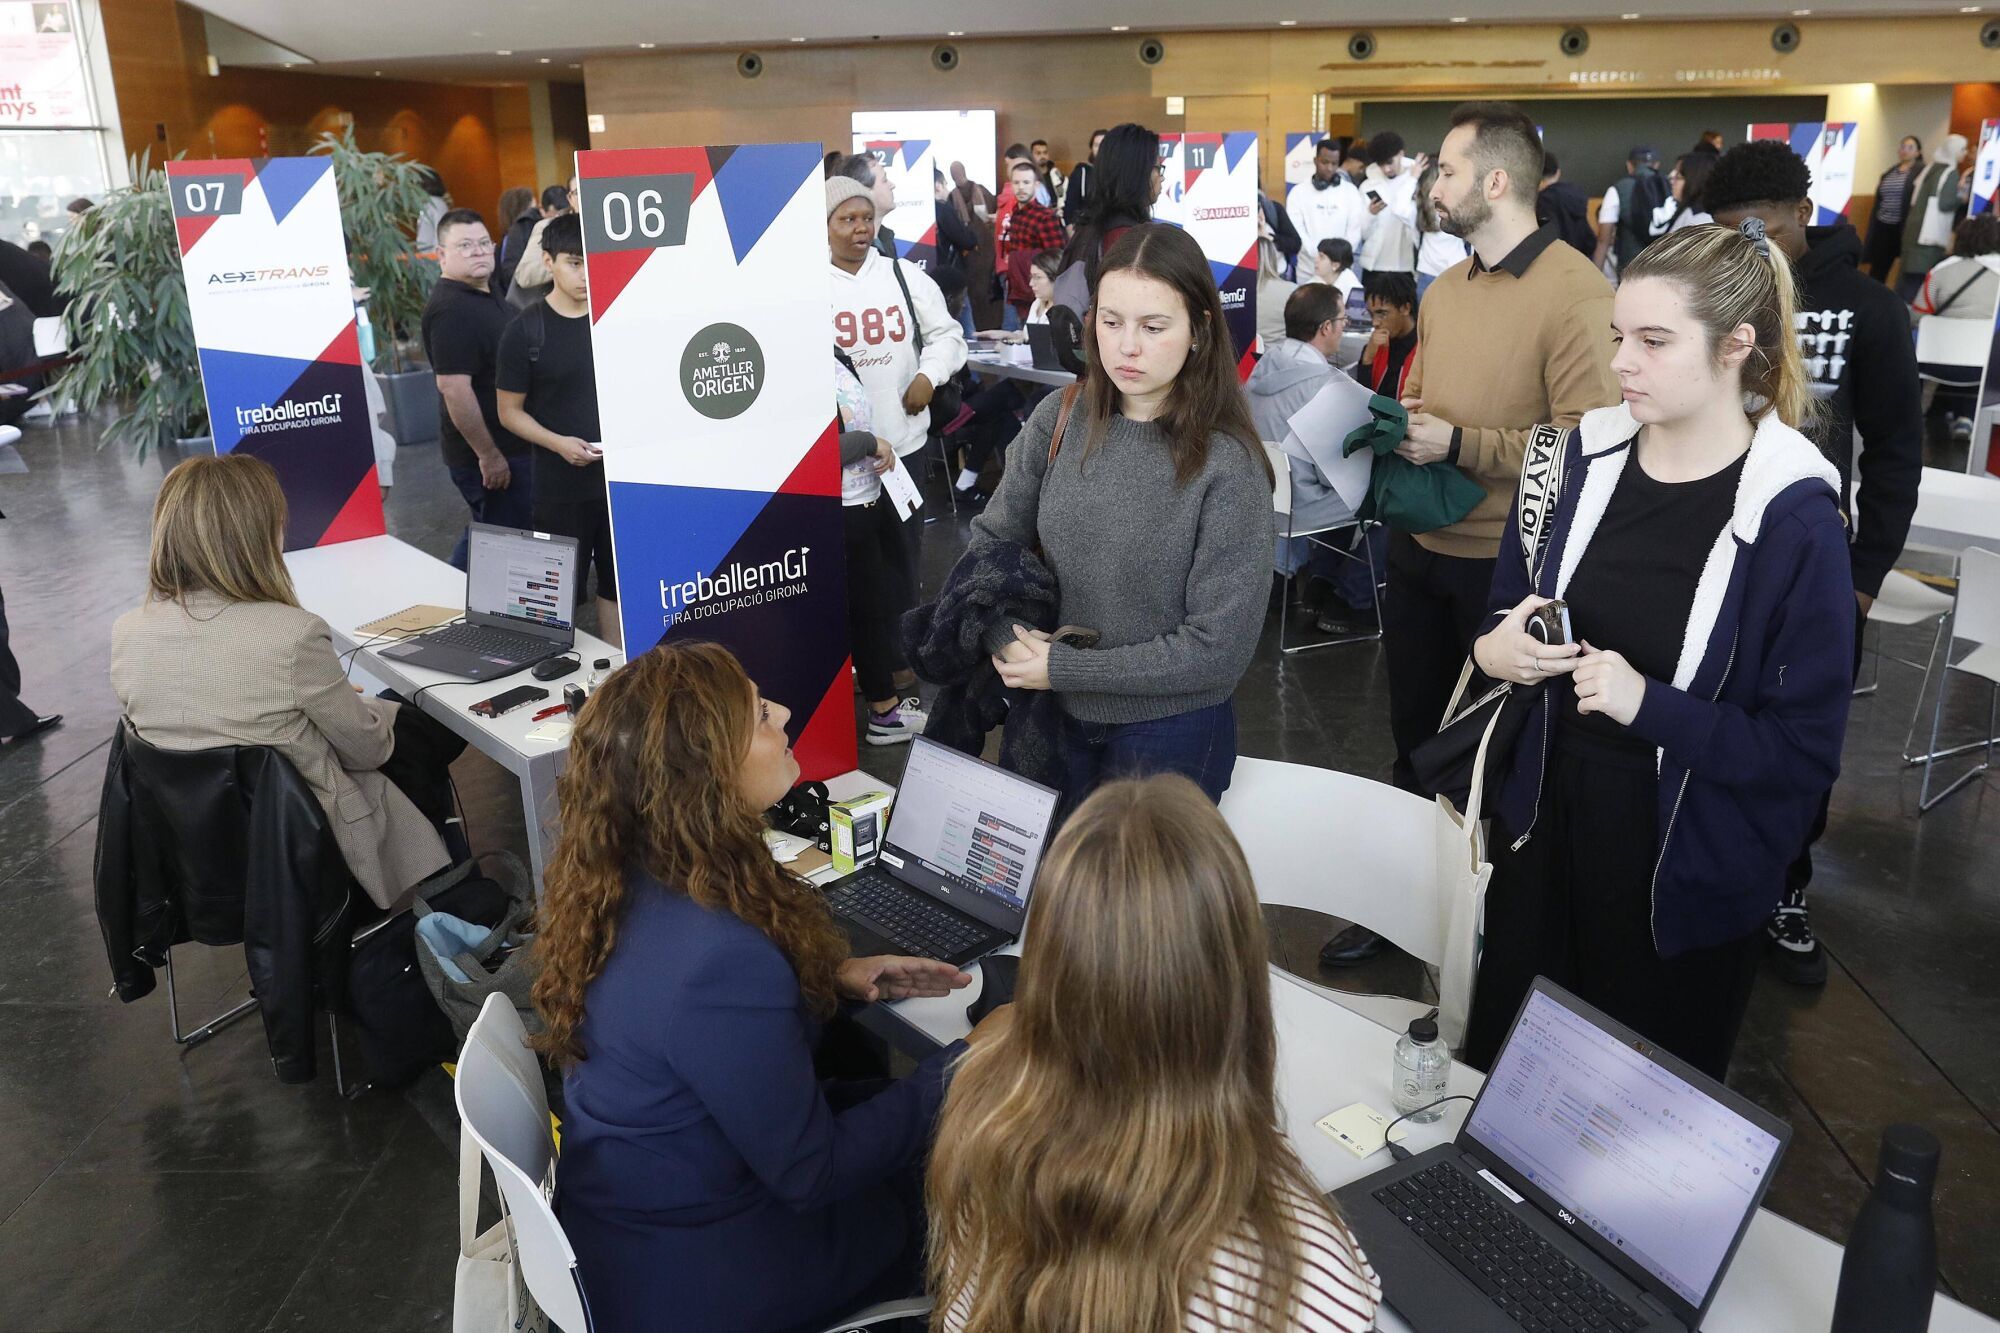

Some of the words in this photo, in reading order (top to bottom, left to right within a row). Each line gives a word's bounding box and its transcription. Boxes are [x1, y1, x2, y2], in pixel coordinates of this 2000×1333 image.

[1192, 147, 1205, 168] 11
[184, 182, 225, 213] 07
[603, 189, 666, 242] 06
[1200, 206, 1250, 220] BAUHAUS
[834, 304, 906, 348] 983
[693, 360, 754, 381] AMETLLER
[692, 373, 755, 399] ORIGEN
[240, 425, 260, 436] FIRA
[311, 414, 342, 426] GIRONA
[663, 610, 692, 628] FIRA
[694, 589, 763, 620] D'OCUPACIÓ
[766, 582, 808, 602] GIRONA
[1558, 1209, 1576, 1225] DELL
